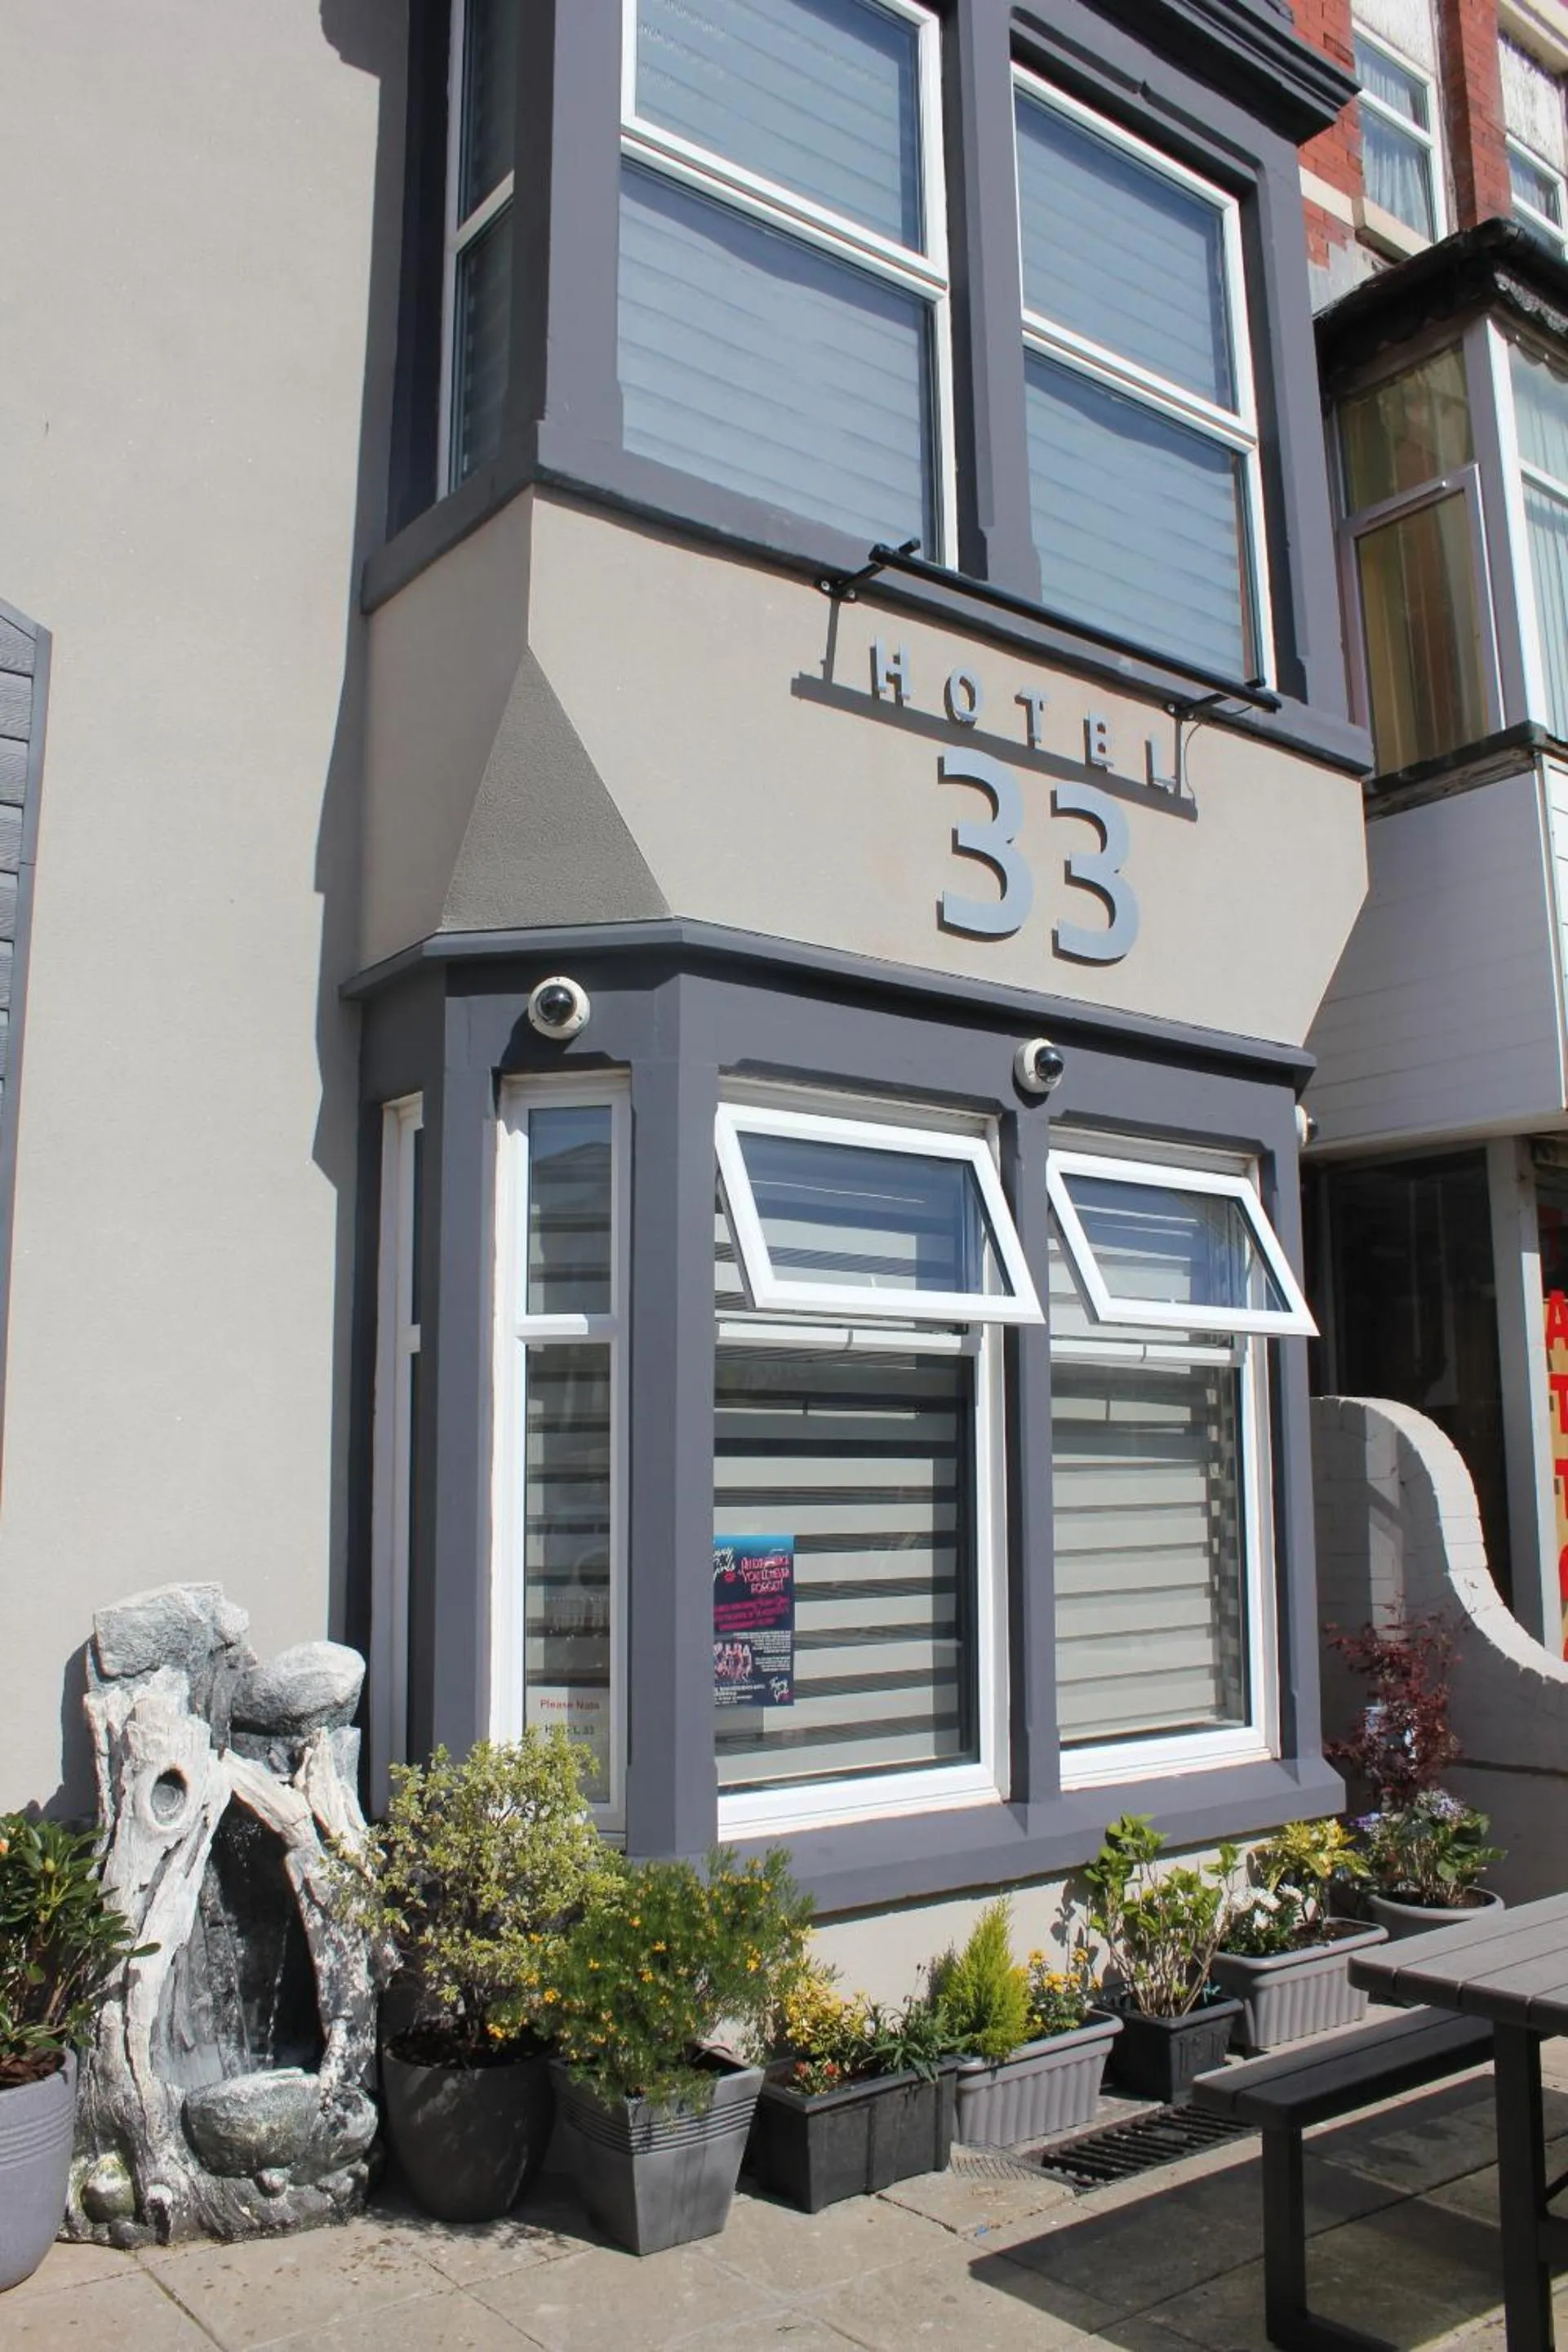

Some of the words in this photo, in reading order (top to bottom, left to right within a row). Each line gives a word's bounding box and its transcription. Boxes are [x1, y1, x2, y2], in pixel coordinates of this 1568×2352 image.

[872, 635, 1177, 789] HOTEL
[939, 745, 1140, 962] 33
[540, 1699, 574, 1710] Please
[575, 1699, 601, 1711] Note
